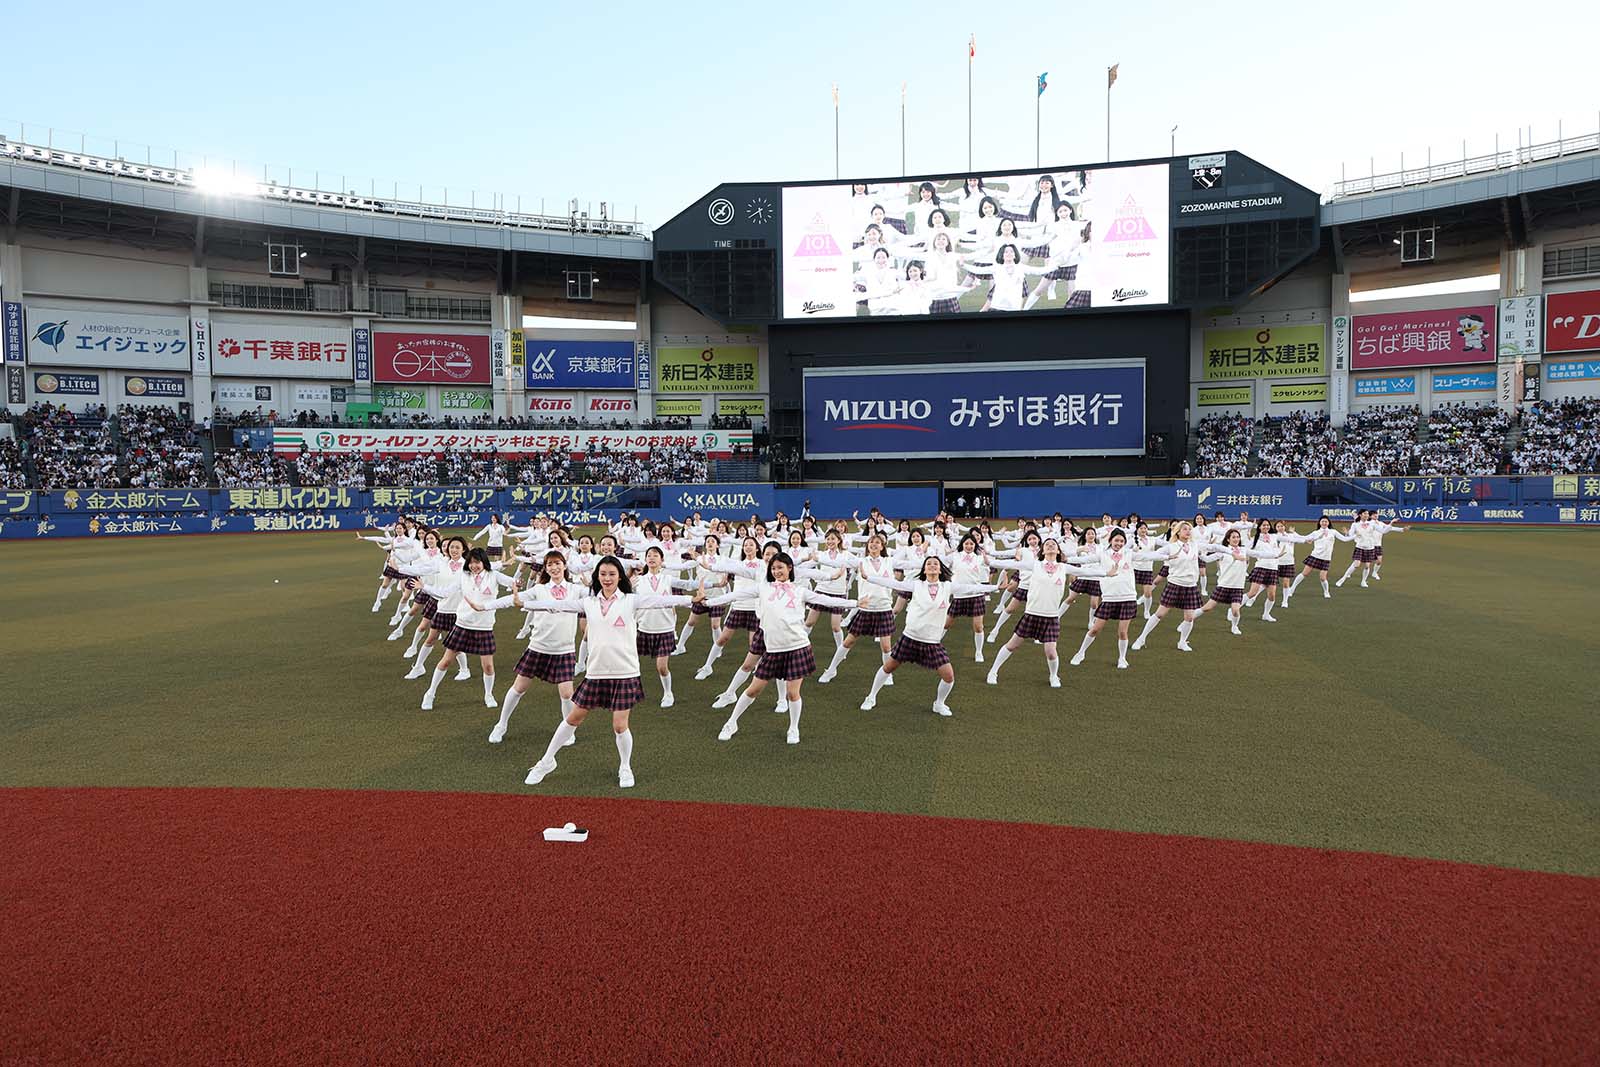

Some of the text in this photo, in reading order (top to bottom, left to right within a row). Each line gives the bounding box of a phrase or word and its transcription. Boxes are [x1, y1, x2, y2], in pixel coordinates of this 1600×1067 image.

[1180, 196, 1283, 213] ZOZOMARINE STADIUM
[713, 240, 732, 248] TIME
[1111, 287, 1149, 302] Marines
[802, 300, 836, 314] Marines
[7, 303, 21, 361] みずほ信託銀行
[81, 323, 181, 337] 人材の総合プロデュース企業
[1403, 320, 1451, 330] Marines!
[75, 335, 187, 355] エイジェック
[197, 331, 206, 361] HTS
[242, 339, 347, 363] 千葉銀行
[511, 332, 523, 366] 加治屋
[1356, 330, 1452, 356] ちば興銀
[493, 342, 504, 377] 保坂設備
[1208, 343, 1320, 368] 新日本建設
[567, 356, 633, 374] 京葉銀行
[661, 363, 755, 382] 新日本建設
[1209, 366, 1320, 379] INTELLIGENT DEVELOPER
[60, 380, 98, 390] B.I.TECH
[148, 382, 184, 392] B.I.TECH
[1273, 389, 1325, 397] エクセレントシティ
[1502, 370, 1511, 401] イノテック
[443, 391, 474, 400] そらまめ
[823, 399, 932, 422] MIZUHO
[949, 392, 1123, 428] みずほ銀行
[85, 492, 201, 511] 金太郎ホーム
[229, 487, 351, 509] 東進ハイスクール
[372, 487, 494, 508] 東京インテリア
[695, 493, 755, 506] KAKUTA
[1216, 494, 1283, 506] 三井住友銀行
[1398, 506, 1460, 521] 田所商店
[1483, 509, 1524, 519] 雪見だいふく
[104, 520, 183, 534] 金太郎ホーム
[253, 514, 341, 531] 東進ハイスクール
